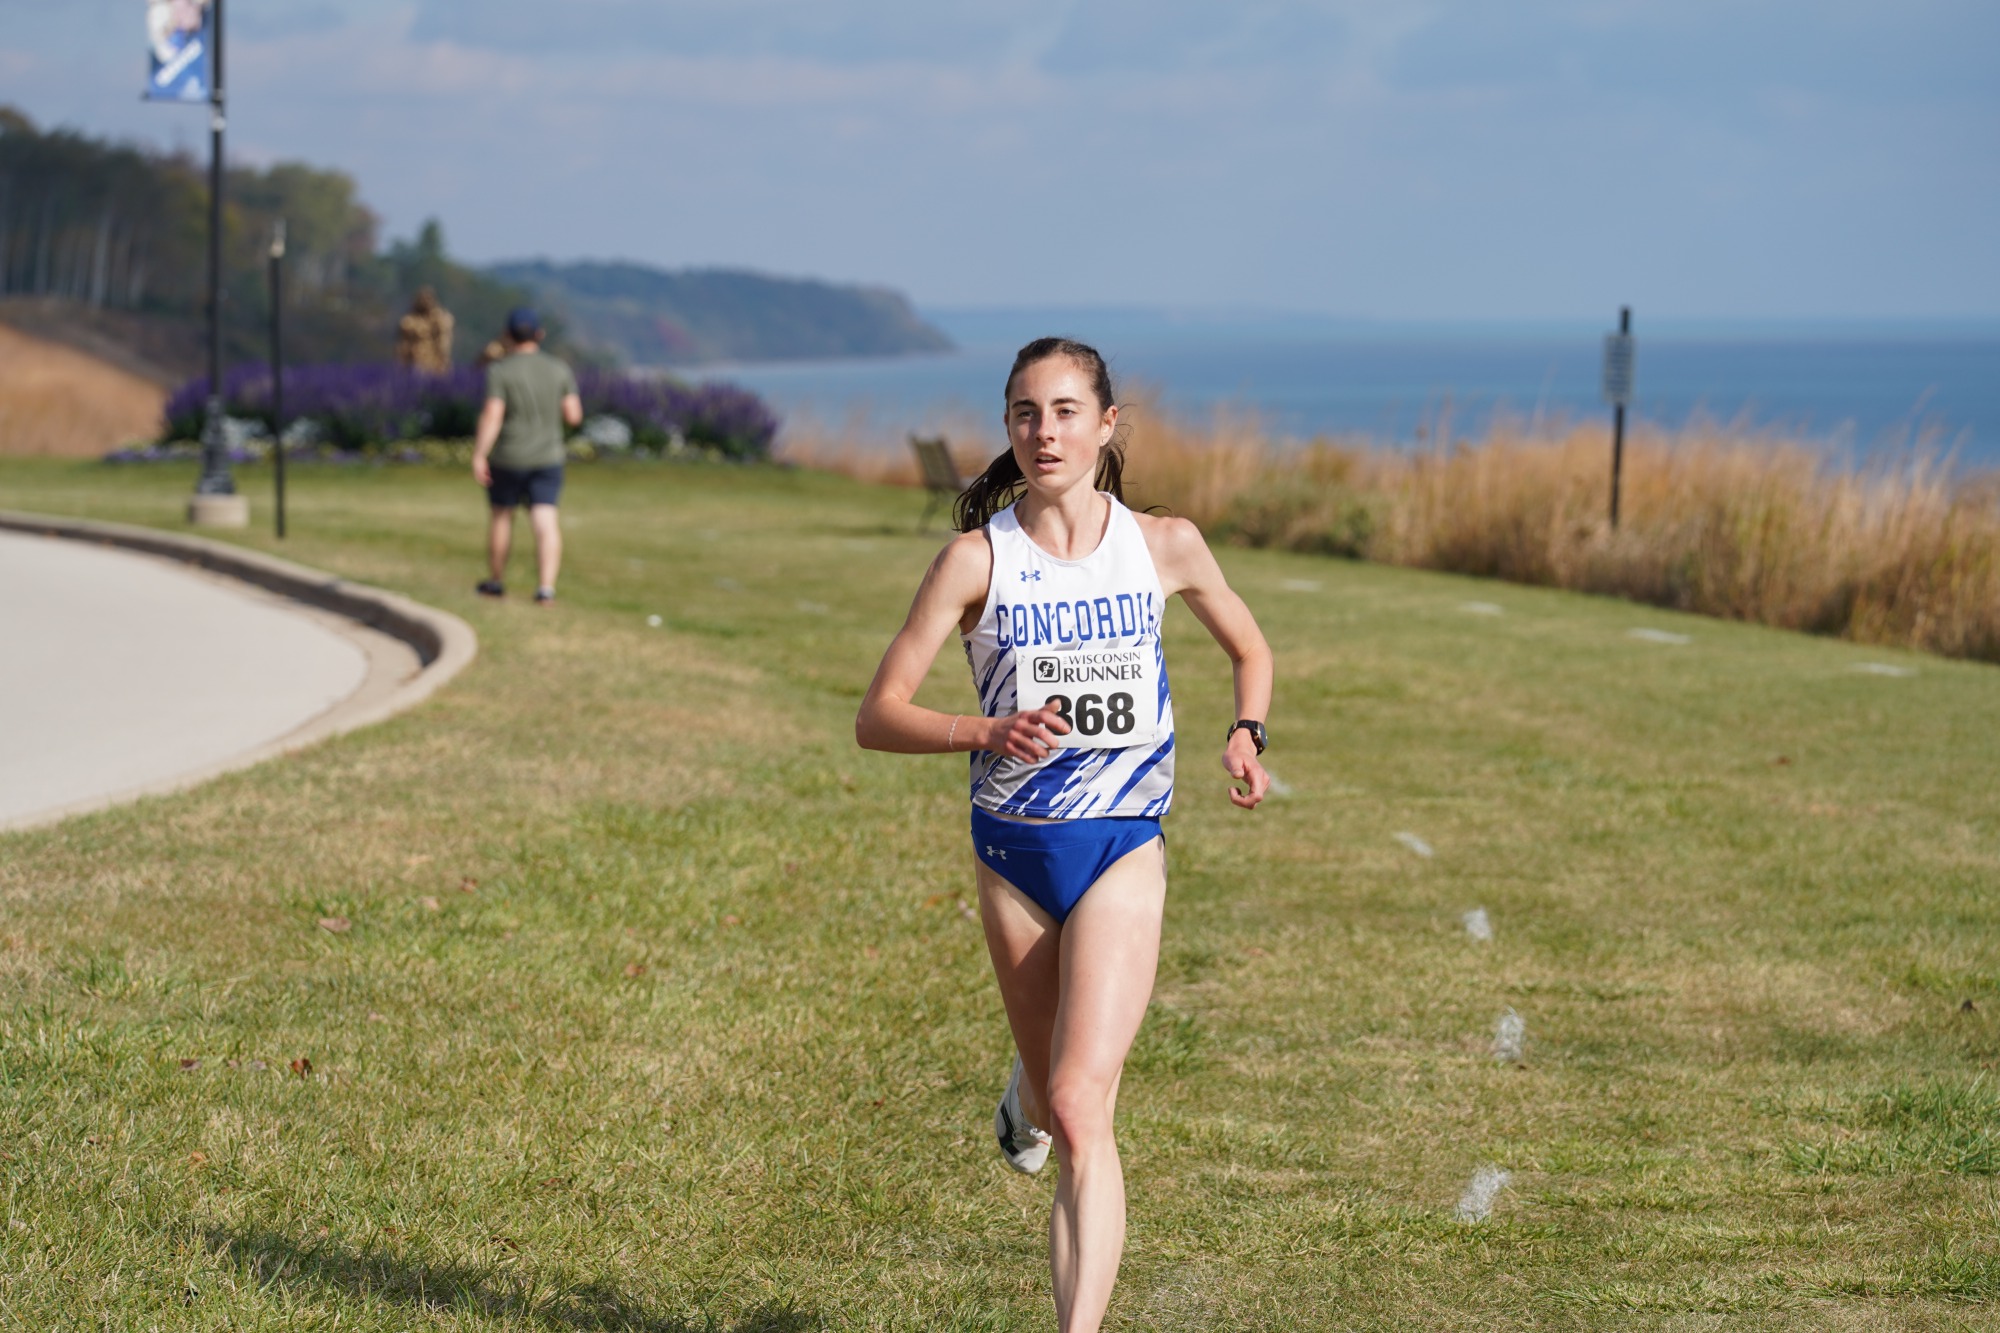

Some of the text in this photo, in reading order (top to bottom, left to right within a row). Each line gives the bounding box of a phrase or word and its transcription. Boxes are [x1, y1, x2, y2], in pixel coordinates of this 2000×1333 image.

[996, 592, 1154, 647] CONCORDIA
[1069, 652, 1141, 664] WISCONSIN
[1064, 664, 1142, 682] RUNNER
